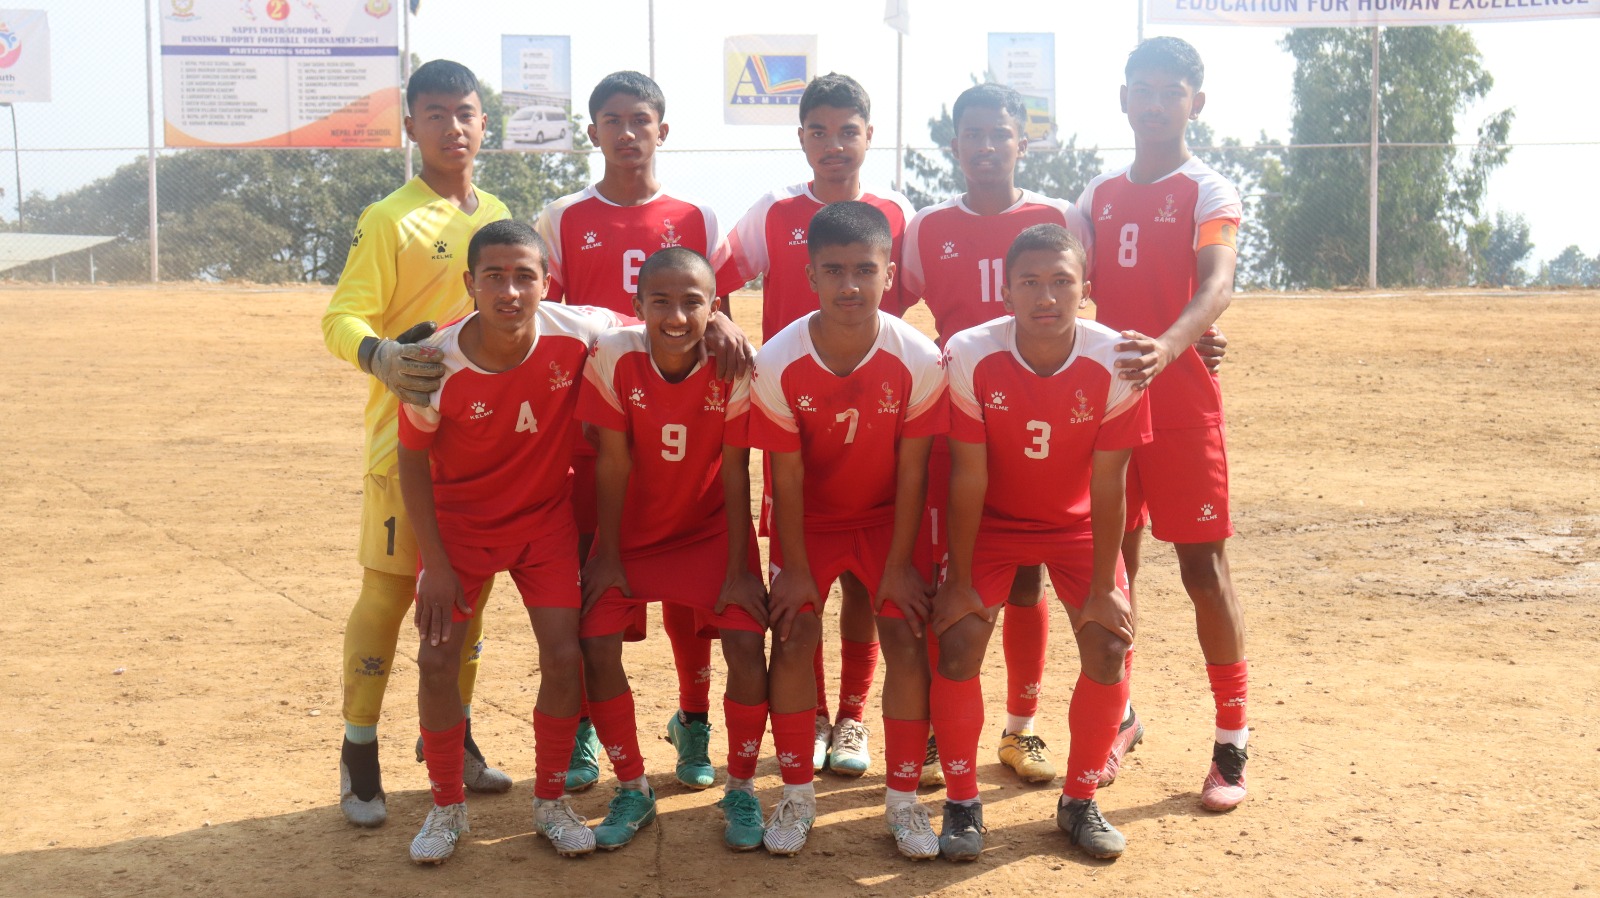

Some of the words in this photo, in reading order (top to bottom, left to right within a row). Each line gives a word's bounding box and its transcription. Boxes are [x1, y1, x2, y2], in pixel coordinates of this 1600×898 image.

[1307, 0, 1349, 12] FOR
[220, 35, 255, 44] TROPHY
[257, 35, 300, 44] FOOTBALL
[229, 47, 293, 55] PARTICIPATING
[295, 47, 332, 55] SCHOOLS
[331, 128, 352, 136] NEPAL
[353, 128, 365, 136] APF
[367, 128, 392, 136] SCHOOL
[581, 241, 602, 250] KELME
[1118, 223, 1139, 268] 8
[940, 252, 959, 260] KELME
[978, 258, 1004, 302] 11
[550, 379, 573, 391] SAMB
[985, 402, 1009, 412] KELME
[470, 409, 494, 420] KELME
[515, 400, 538, 434] 4
[1070, 415, 1094, 424] SAMB
[836, 407, 859, 445] 7
[661, 423, 687, 462] 9
[1024, 419, 1052, 460] 3
[1197, 514, 1218, 522] KELME
[384, 516, 396, 556] 1
